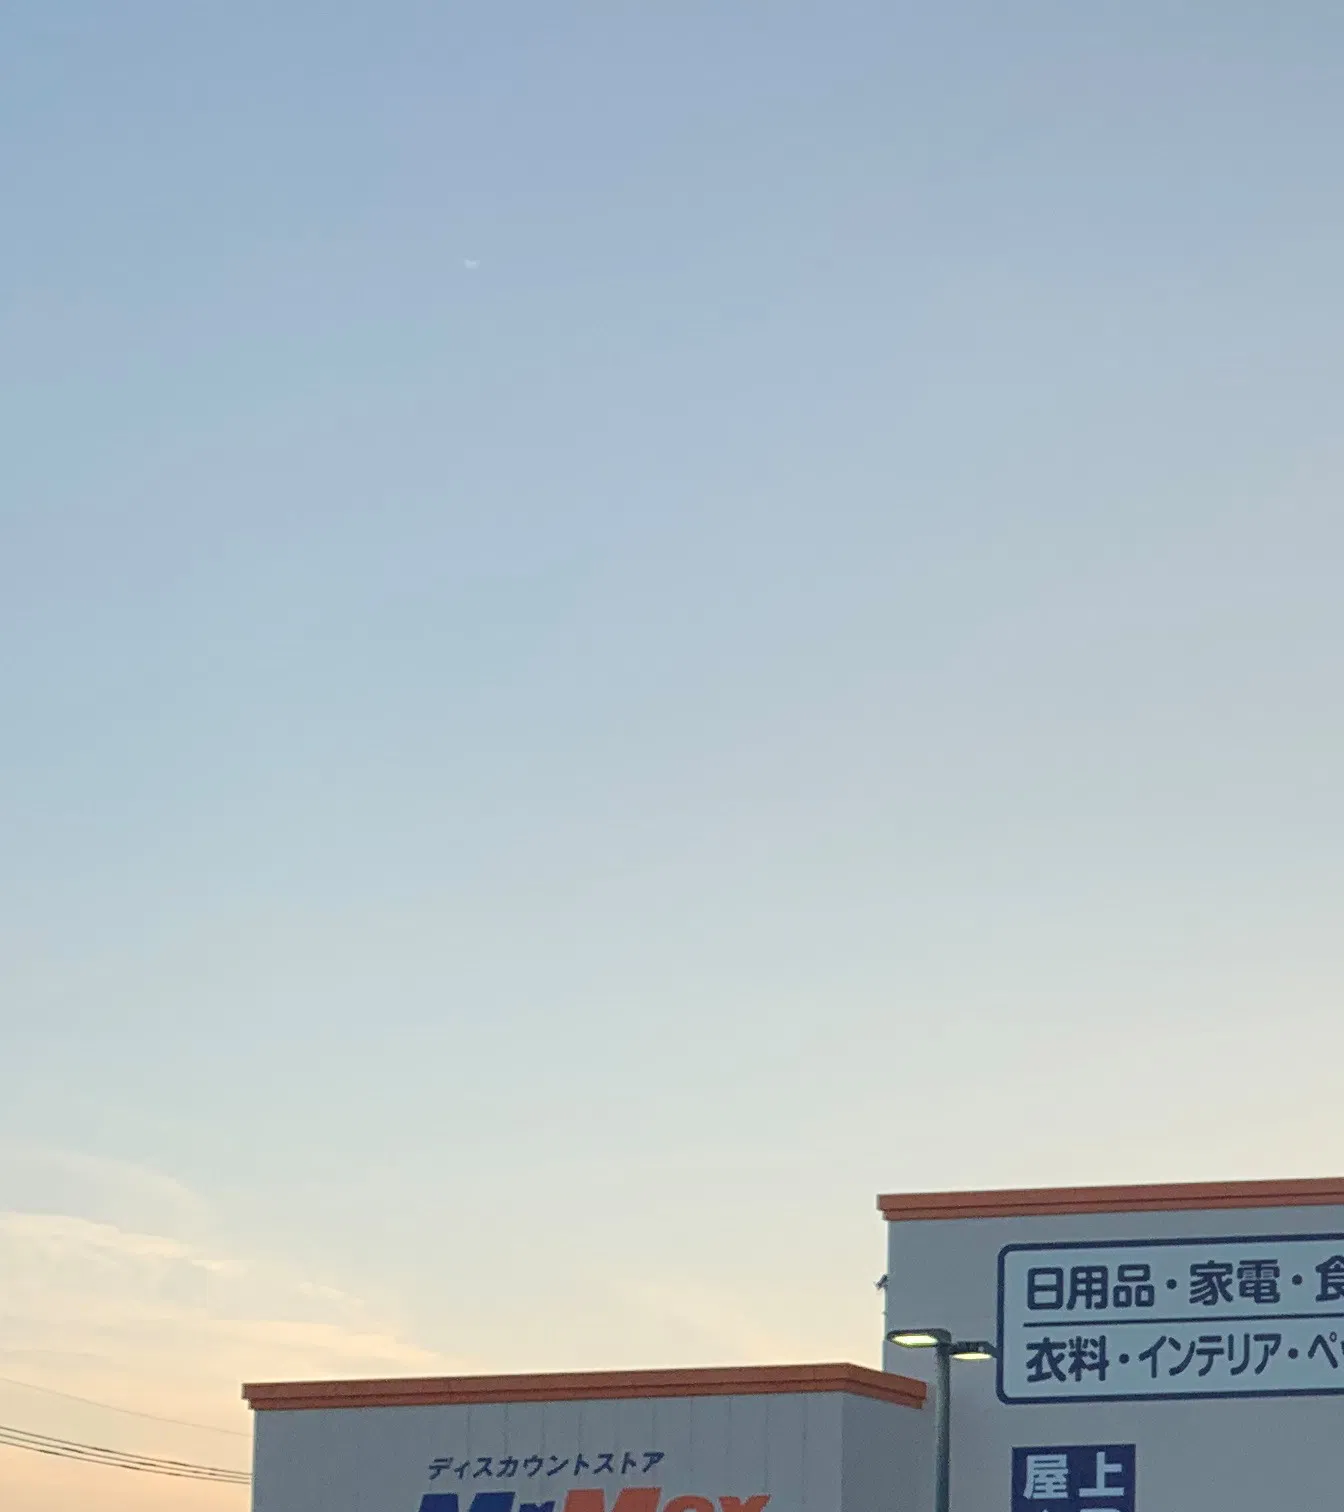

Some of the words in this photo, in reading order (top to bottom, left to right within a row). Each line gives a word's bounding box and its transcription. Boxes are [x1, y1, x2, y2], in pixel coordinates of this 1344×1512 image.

[427, 1451, 665, 1480] ディスカウントストア
[1023, 1452, 1125, 1500] 屋上
